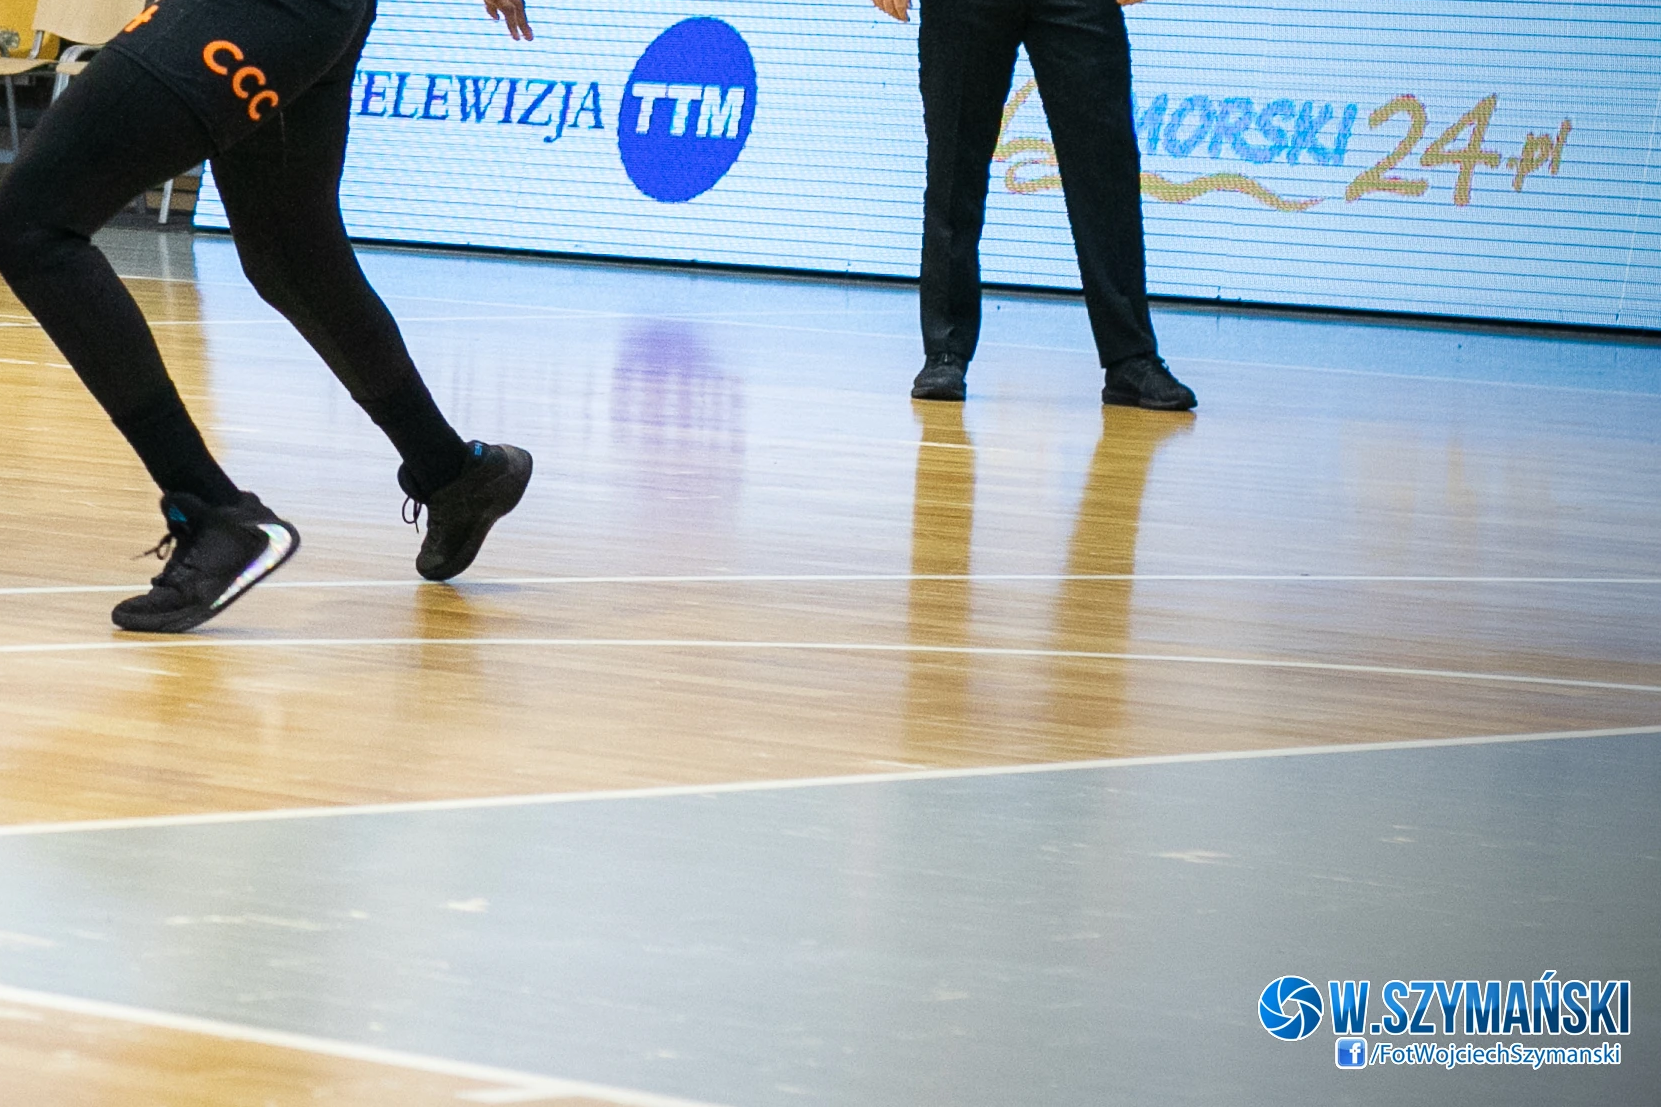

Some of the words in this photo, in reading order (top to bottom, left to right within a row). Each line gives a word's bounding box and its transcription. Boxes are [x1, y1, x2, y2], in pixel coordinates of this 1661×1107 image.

[203, 40, 279, 121] CCC
[353, 70, 605, 143] ELEWIZJA
[632, 82, 745, 140] TTM
